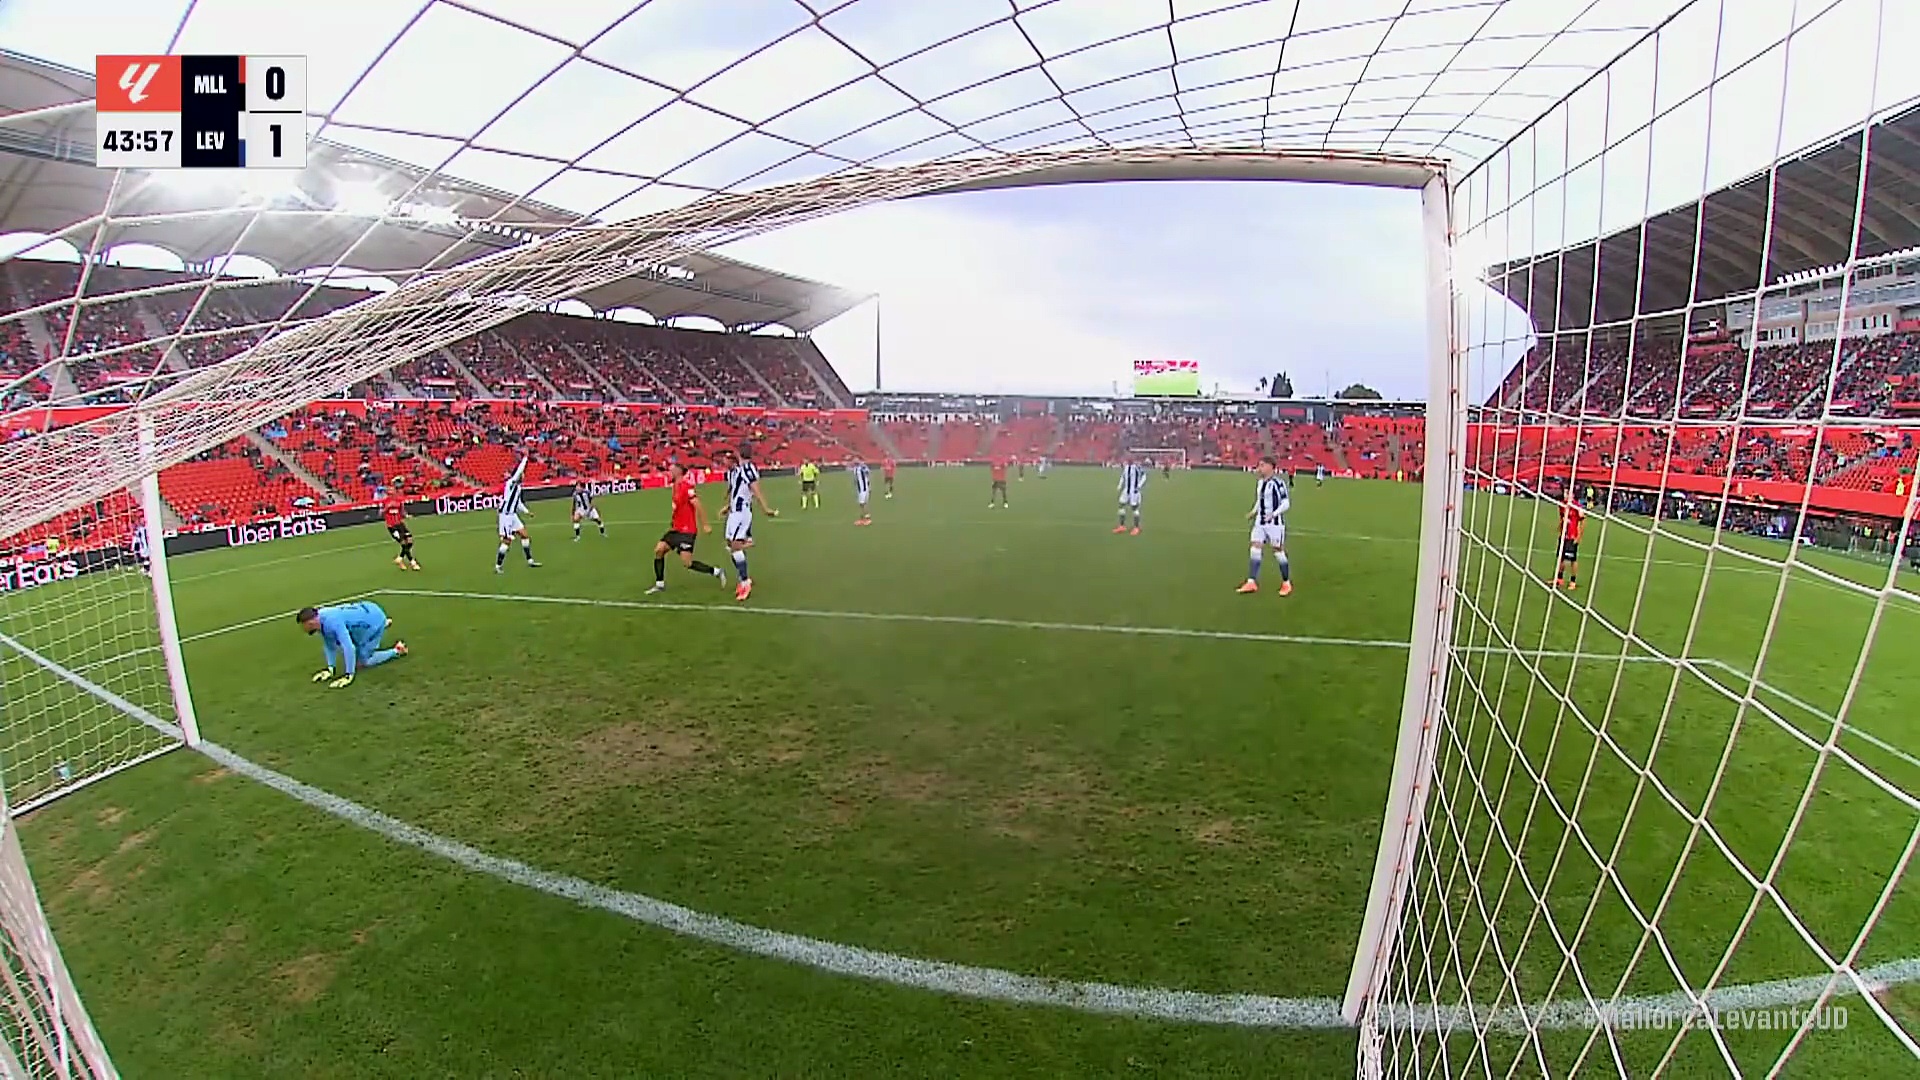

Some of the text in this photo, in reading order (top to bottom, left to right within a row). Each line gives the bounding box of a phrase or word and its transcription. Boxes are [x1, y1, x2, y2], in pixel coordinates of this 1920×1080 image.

[435, 494, 472, 515] Uber
[227, 516, 327, 547] Uber Eats
